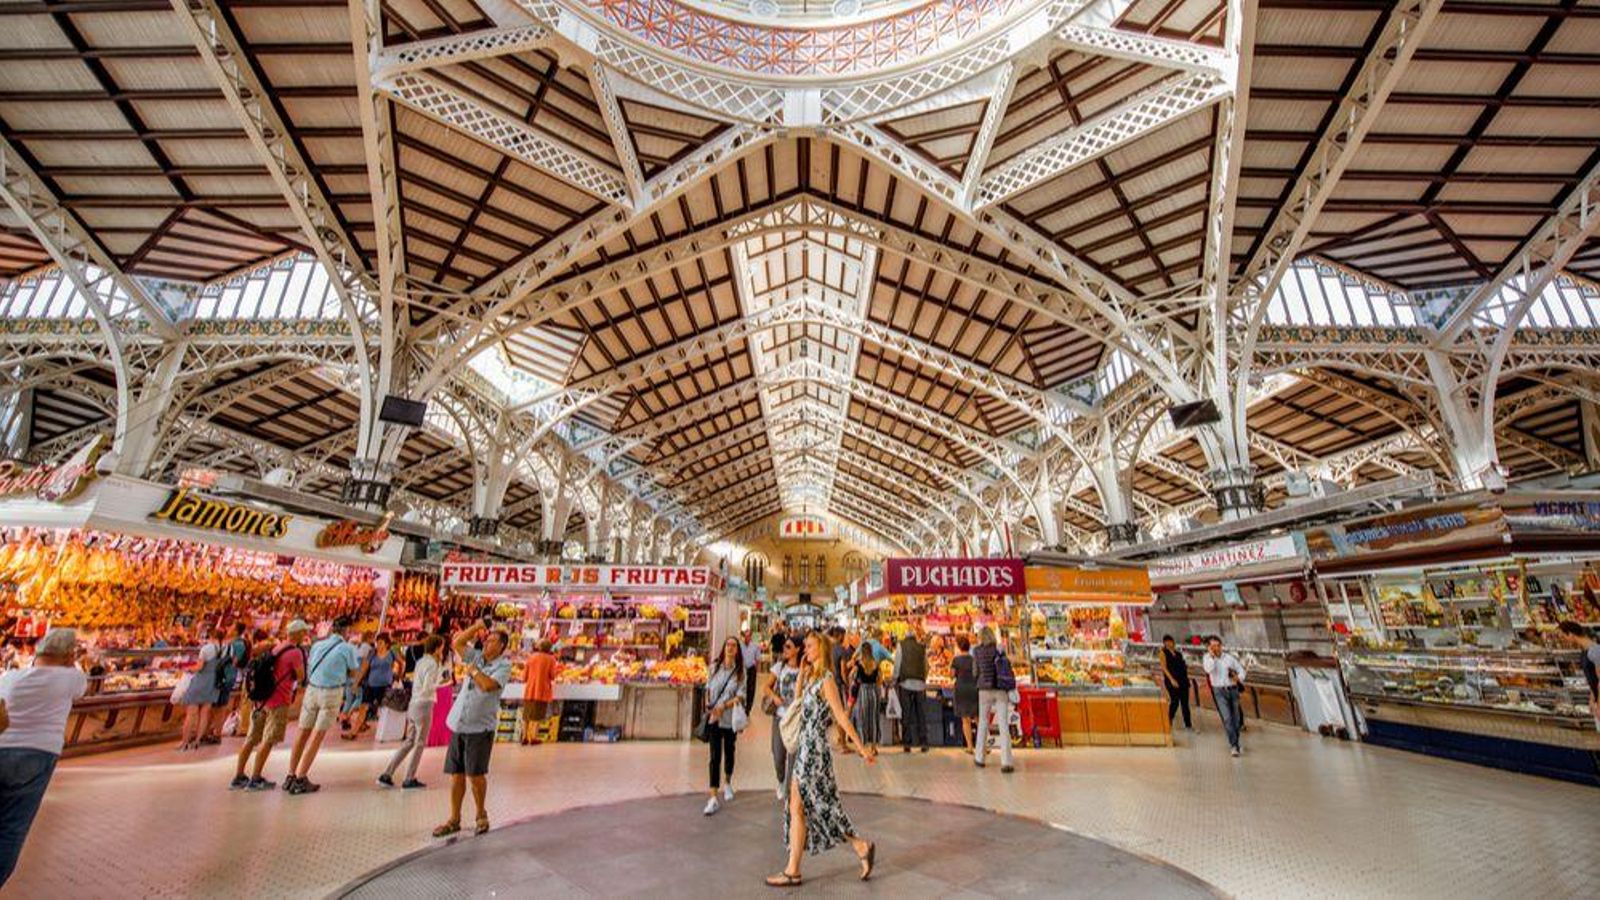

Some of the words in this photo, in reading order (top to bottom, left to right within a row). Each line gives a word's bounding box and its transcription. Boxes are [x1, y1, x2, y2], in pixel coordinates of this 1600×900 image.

[156, 487, 293, 539] Jamones
[443, 566, 536, 583] FRUTAS
[611, 568, 706, 584] FRUTAS
[901, 566, 1013, 587] PUCHADES
